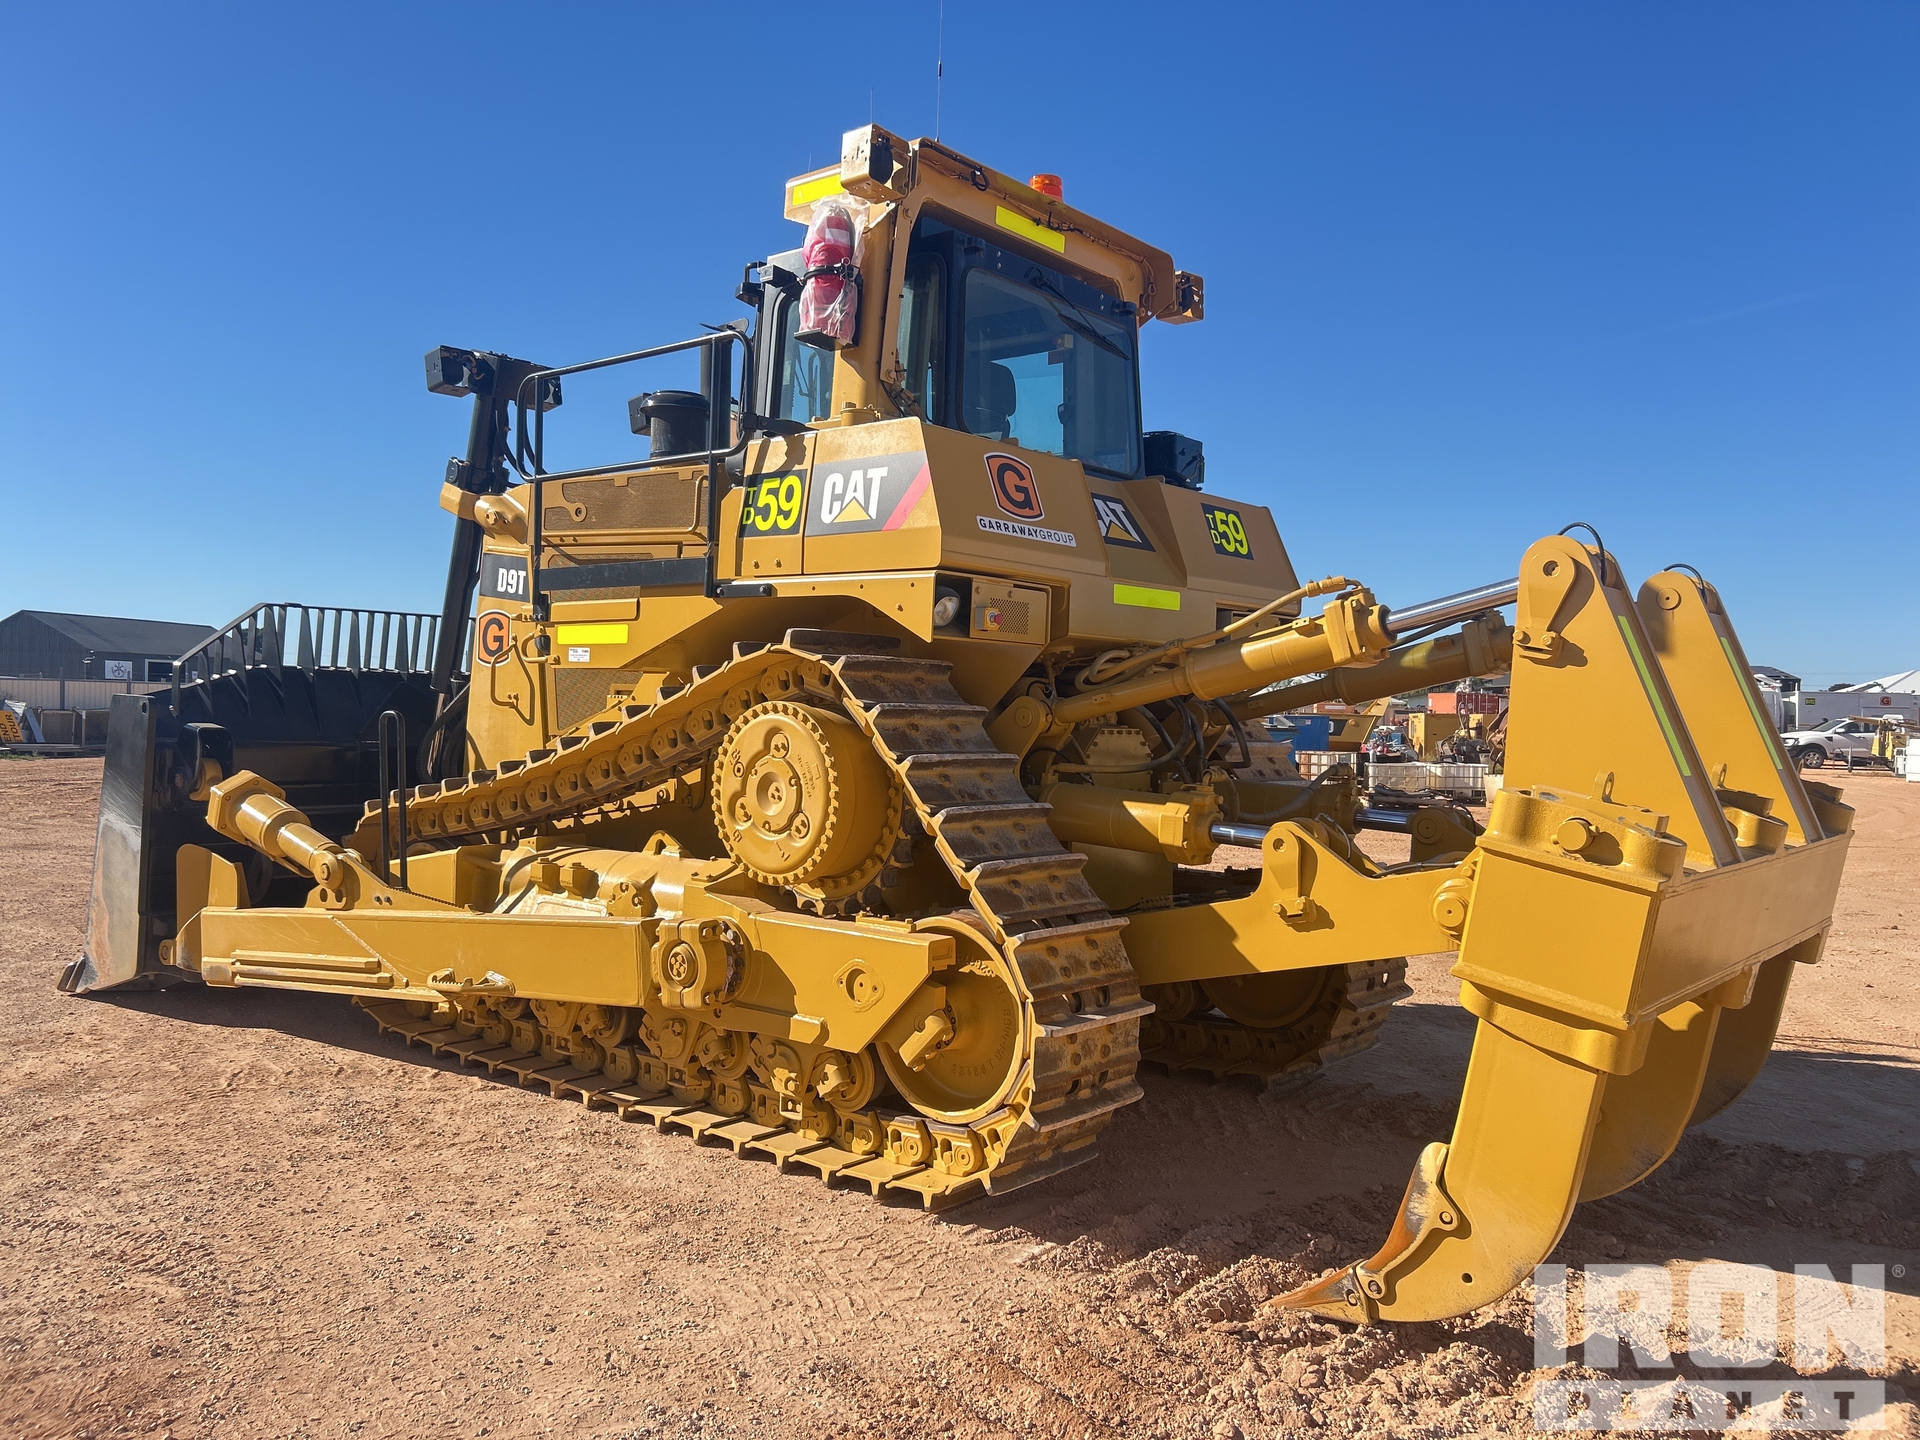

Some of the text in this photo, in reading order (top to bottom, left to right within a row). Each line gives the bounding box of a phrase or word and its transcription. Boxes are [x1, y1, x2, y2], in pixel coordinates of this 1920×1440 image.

[754, 475, 802, 531] 59
[820, 466, 888, 524] CAT
[997, 462, 1035, 511] G
[1214, 510, 1249, 555] 59
[497, 567, 526, 595] D9T
[482, 617, 505, 657] G
